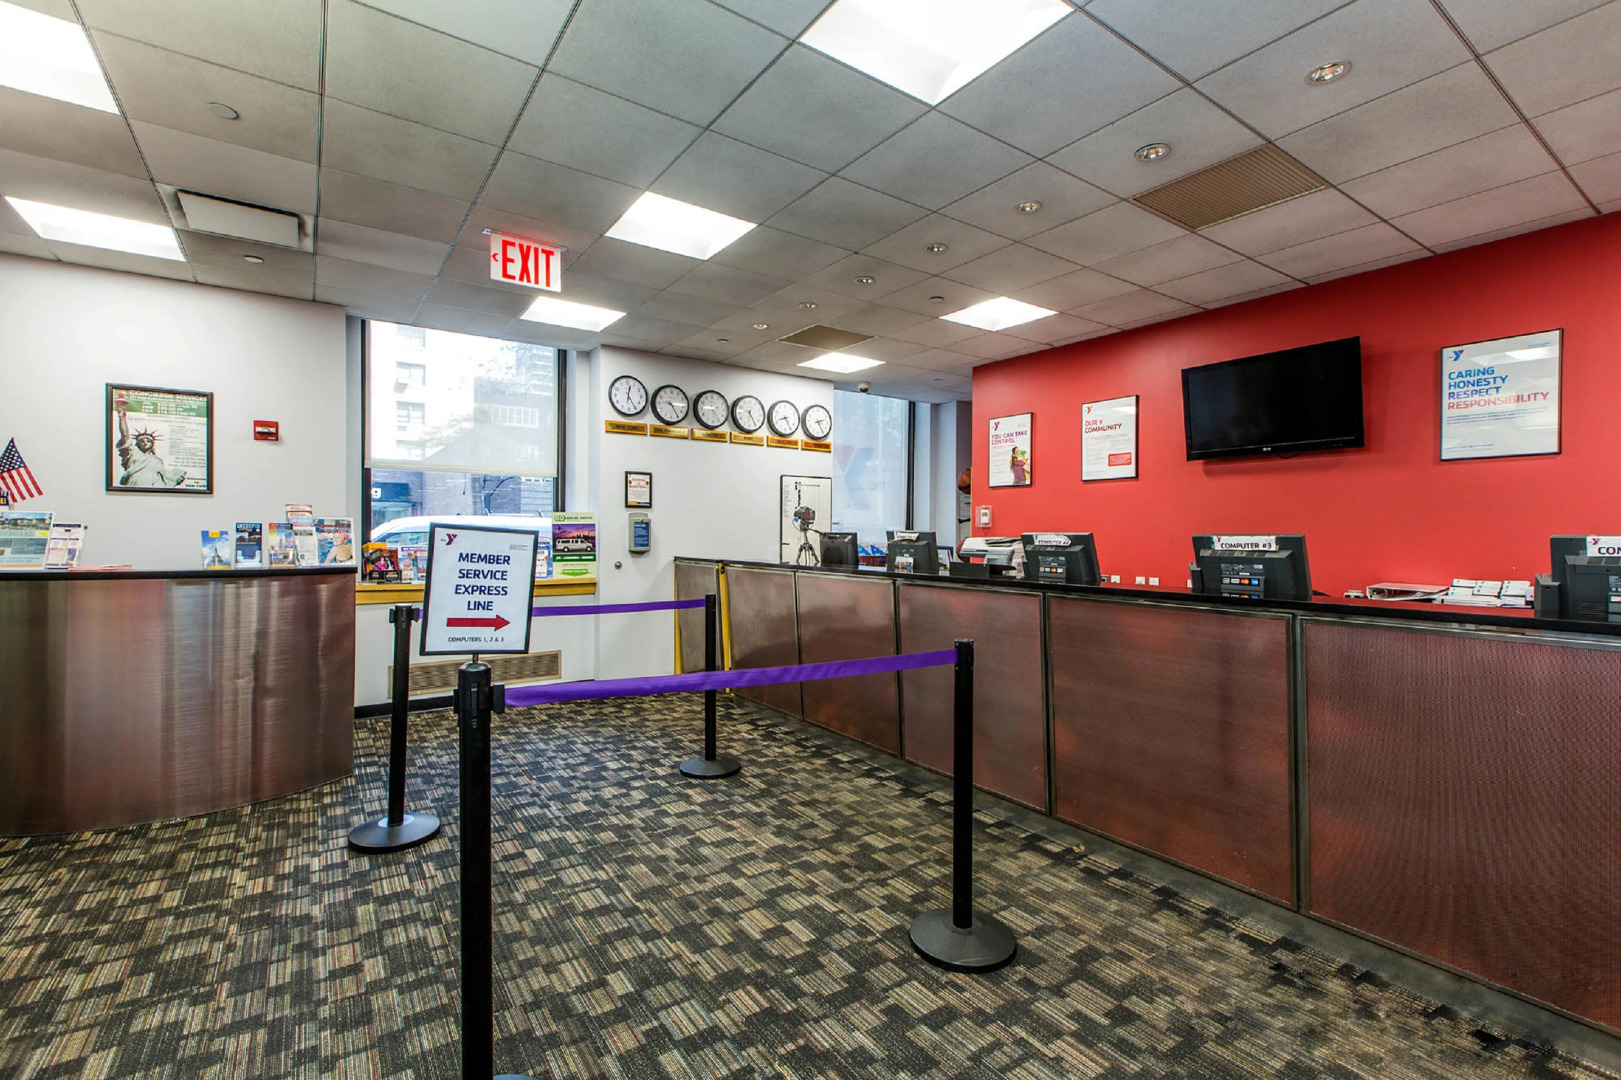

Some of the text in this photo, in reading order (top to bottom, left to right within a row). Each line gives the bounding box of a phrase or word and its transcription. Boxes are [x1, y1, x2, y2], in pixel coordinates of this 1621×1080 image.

[501, 239, 555, 288] EXIT
[1448, 366, 1495, 381] CARING
[1448, 375, 1508, 391] HONESTY
[1447, 386, 1502, 401] RESPECT
[1447, 391, 1550, 411] RESPONSIBILITY
[1084, 419, 1098, 427] OUR
[1084, 423, 1122, 434] COMMUNITY
[991, 438, 1015, 446] CONTROL
[458, 552, 511, 565] MEMBER
[458, 568, 508, 581] SERVICE
[454, 584, 508, 596] EXPRESS
[467, 600, 494, 611] LINE
